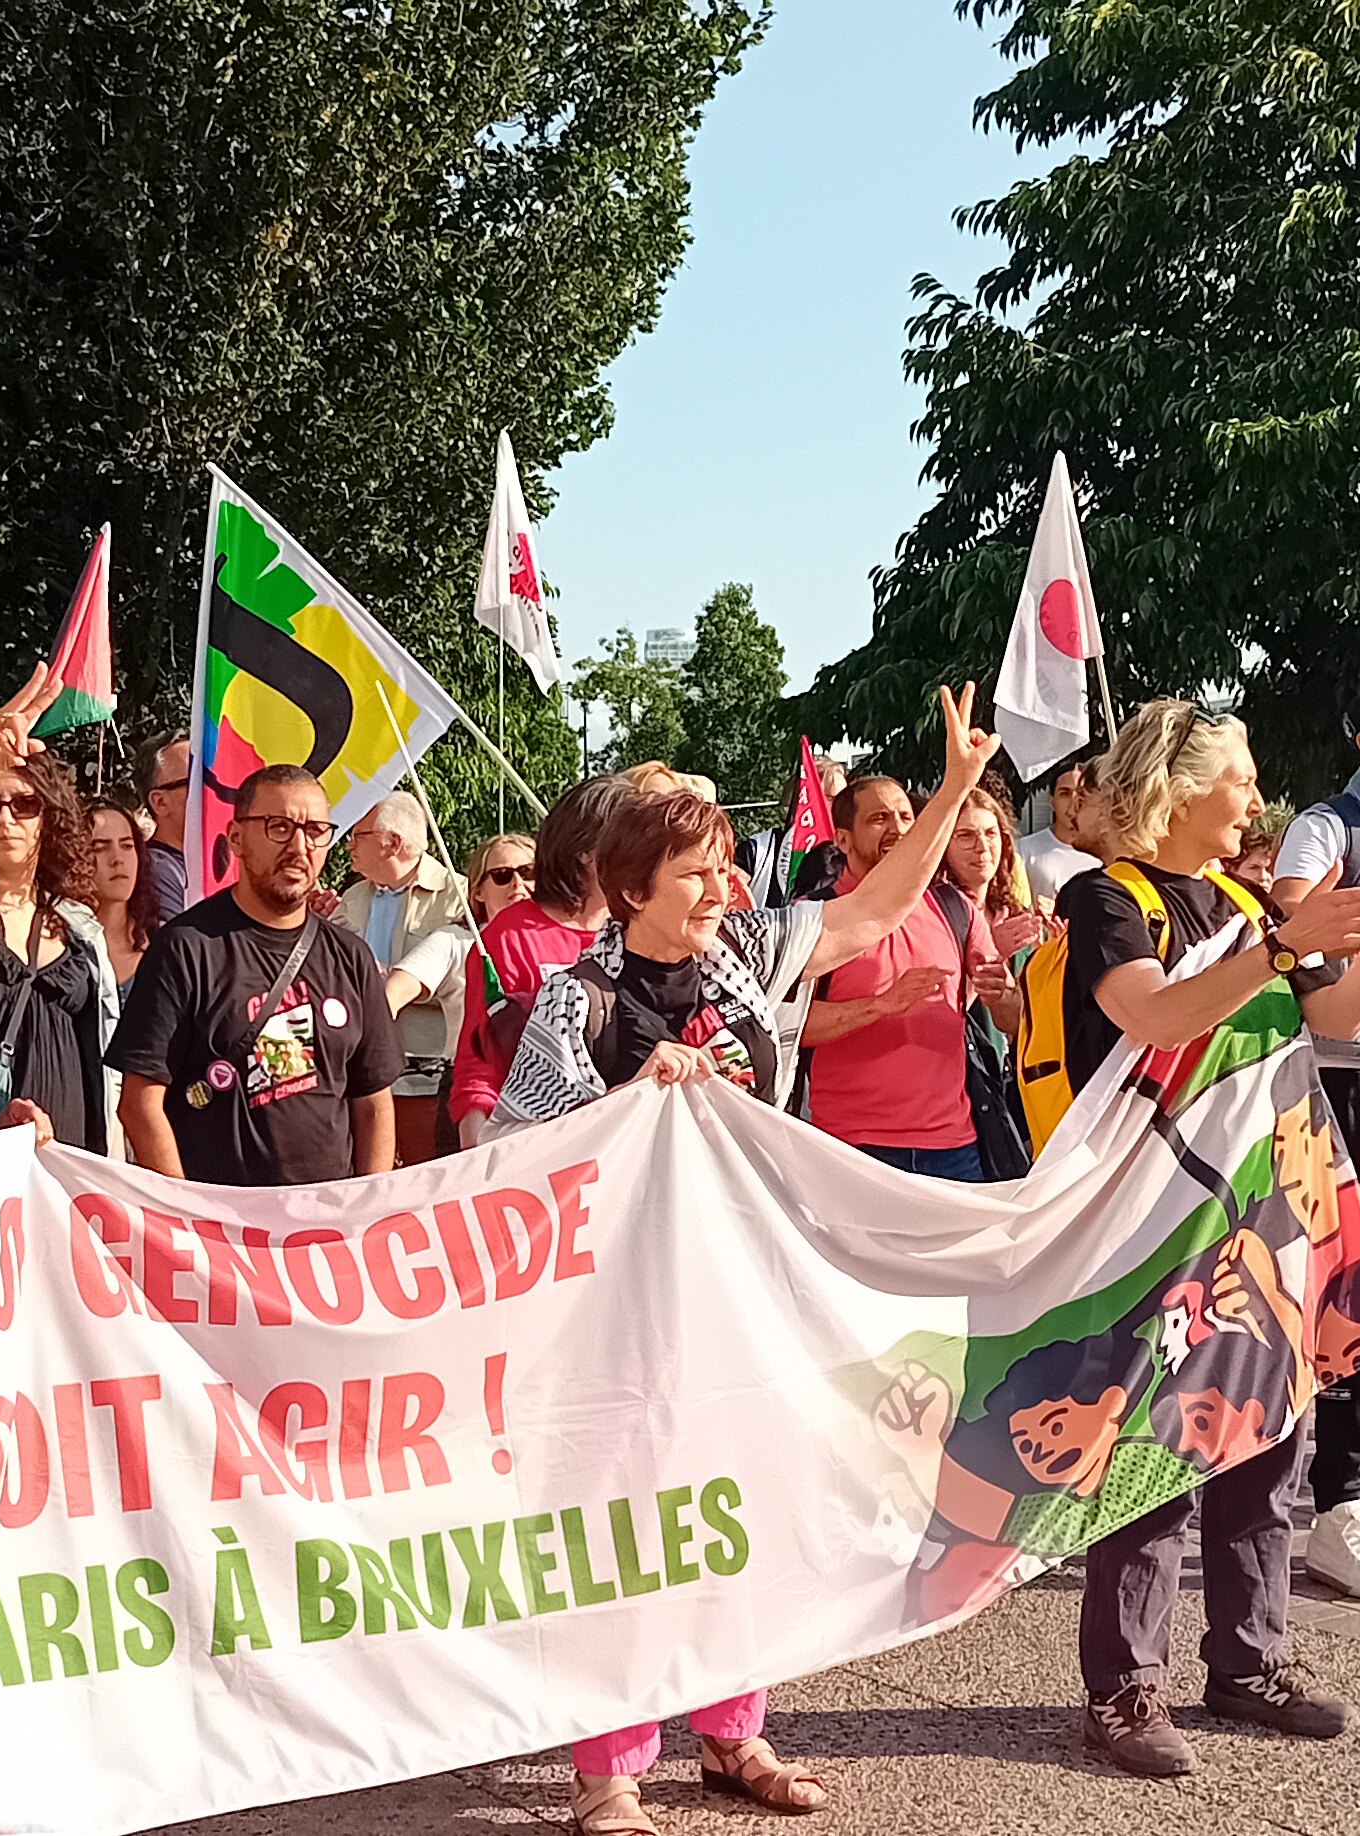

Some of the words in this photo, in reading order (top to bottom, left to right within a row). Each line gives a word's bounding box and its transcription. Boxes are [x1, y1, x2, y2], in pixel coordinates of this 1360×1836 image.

[70, 1159, 598, 1327] GENOCIDE
[210, 1372, 451, 1503] AGIR
[210, 1526, 272, 1657] À
[296, 1477, 749, 1644] BRUXELLES
